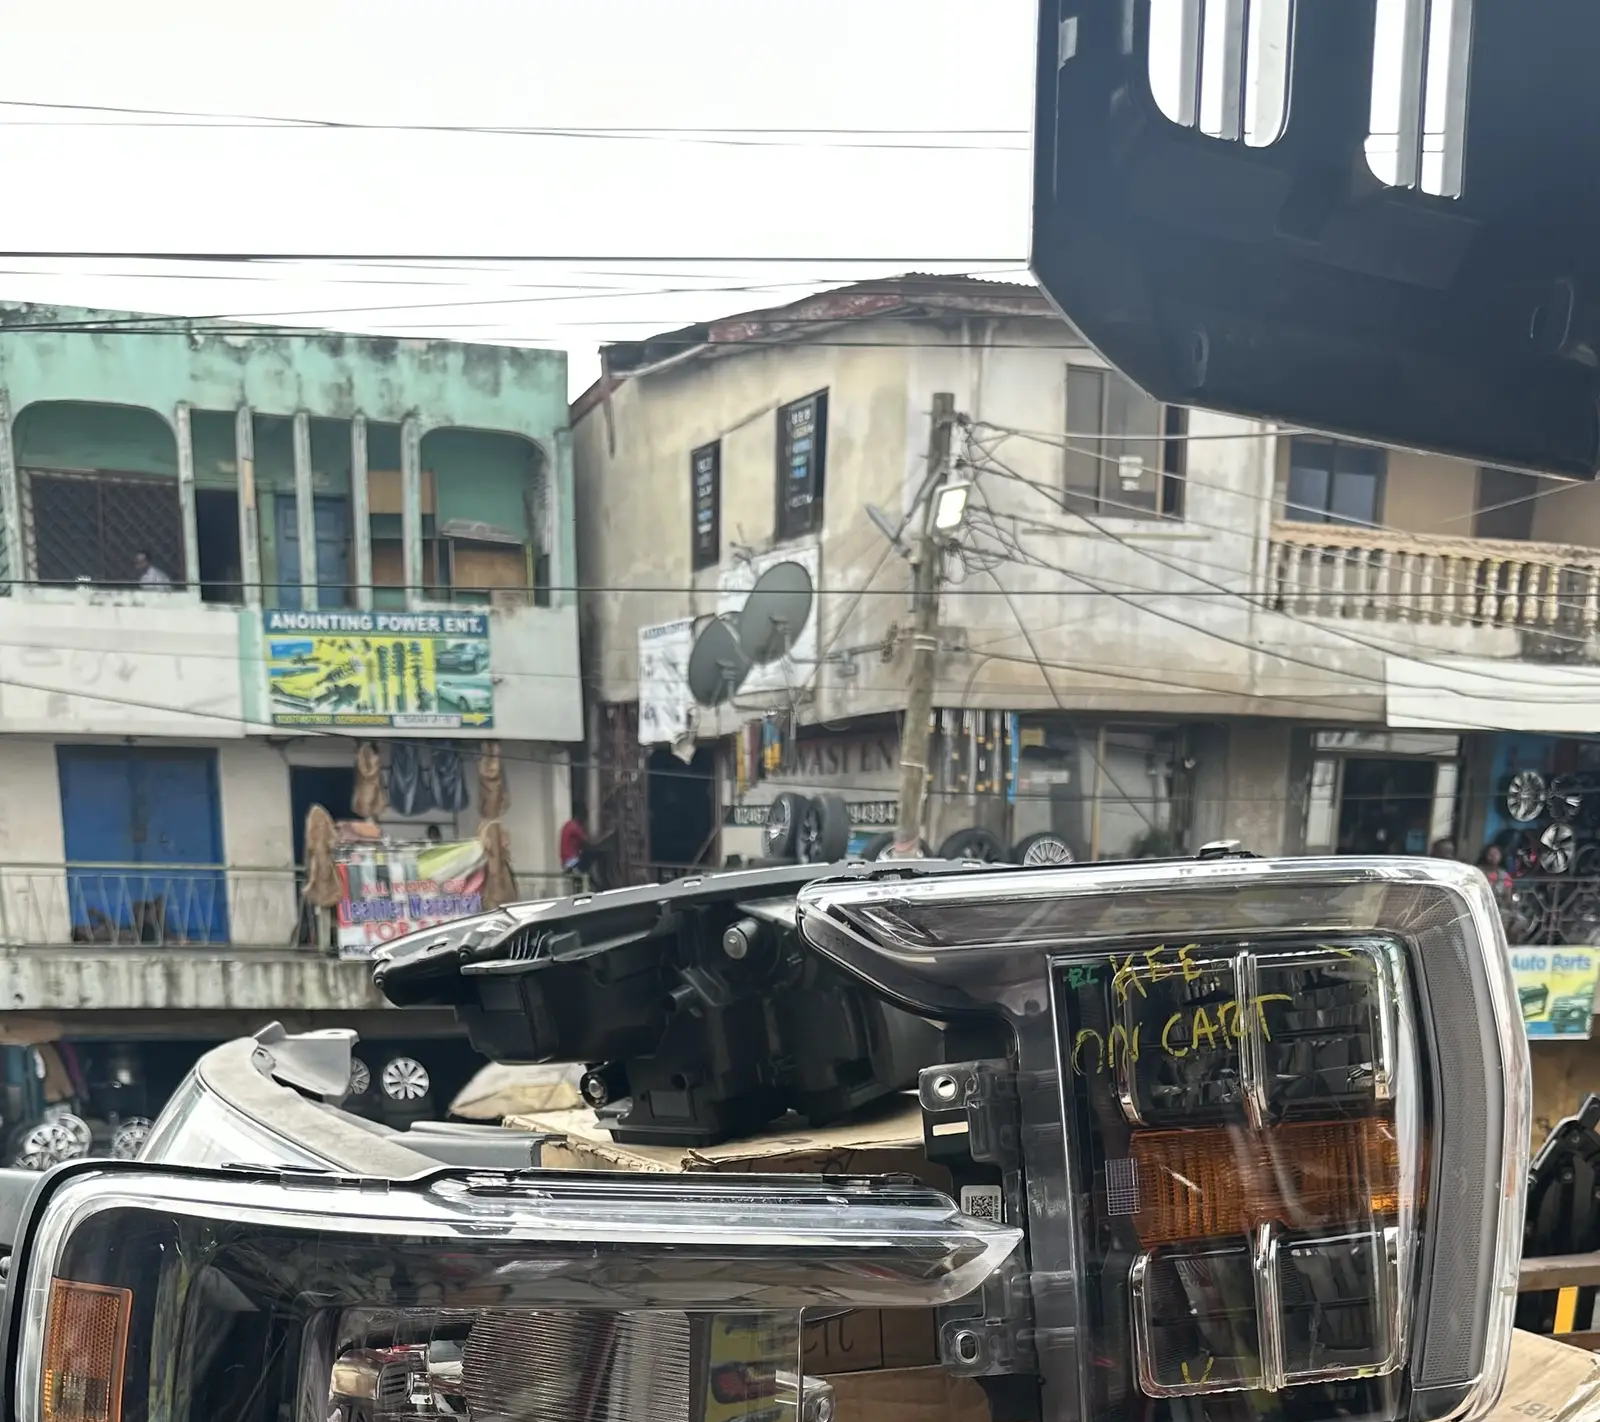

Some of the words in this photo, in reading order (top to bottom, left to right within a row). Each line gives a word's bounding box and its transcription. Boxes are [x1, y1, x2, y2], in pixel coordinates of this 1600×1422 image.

[270, 613, 374, 631] ANOINTING
[376, 616, 441, 633] POWER
[443, 618, 483, 634] ENT.
[1551, 953, 1592, 972] Parts
